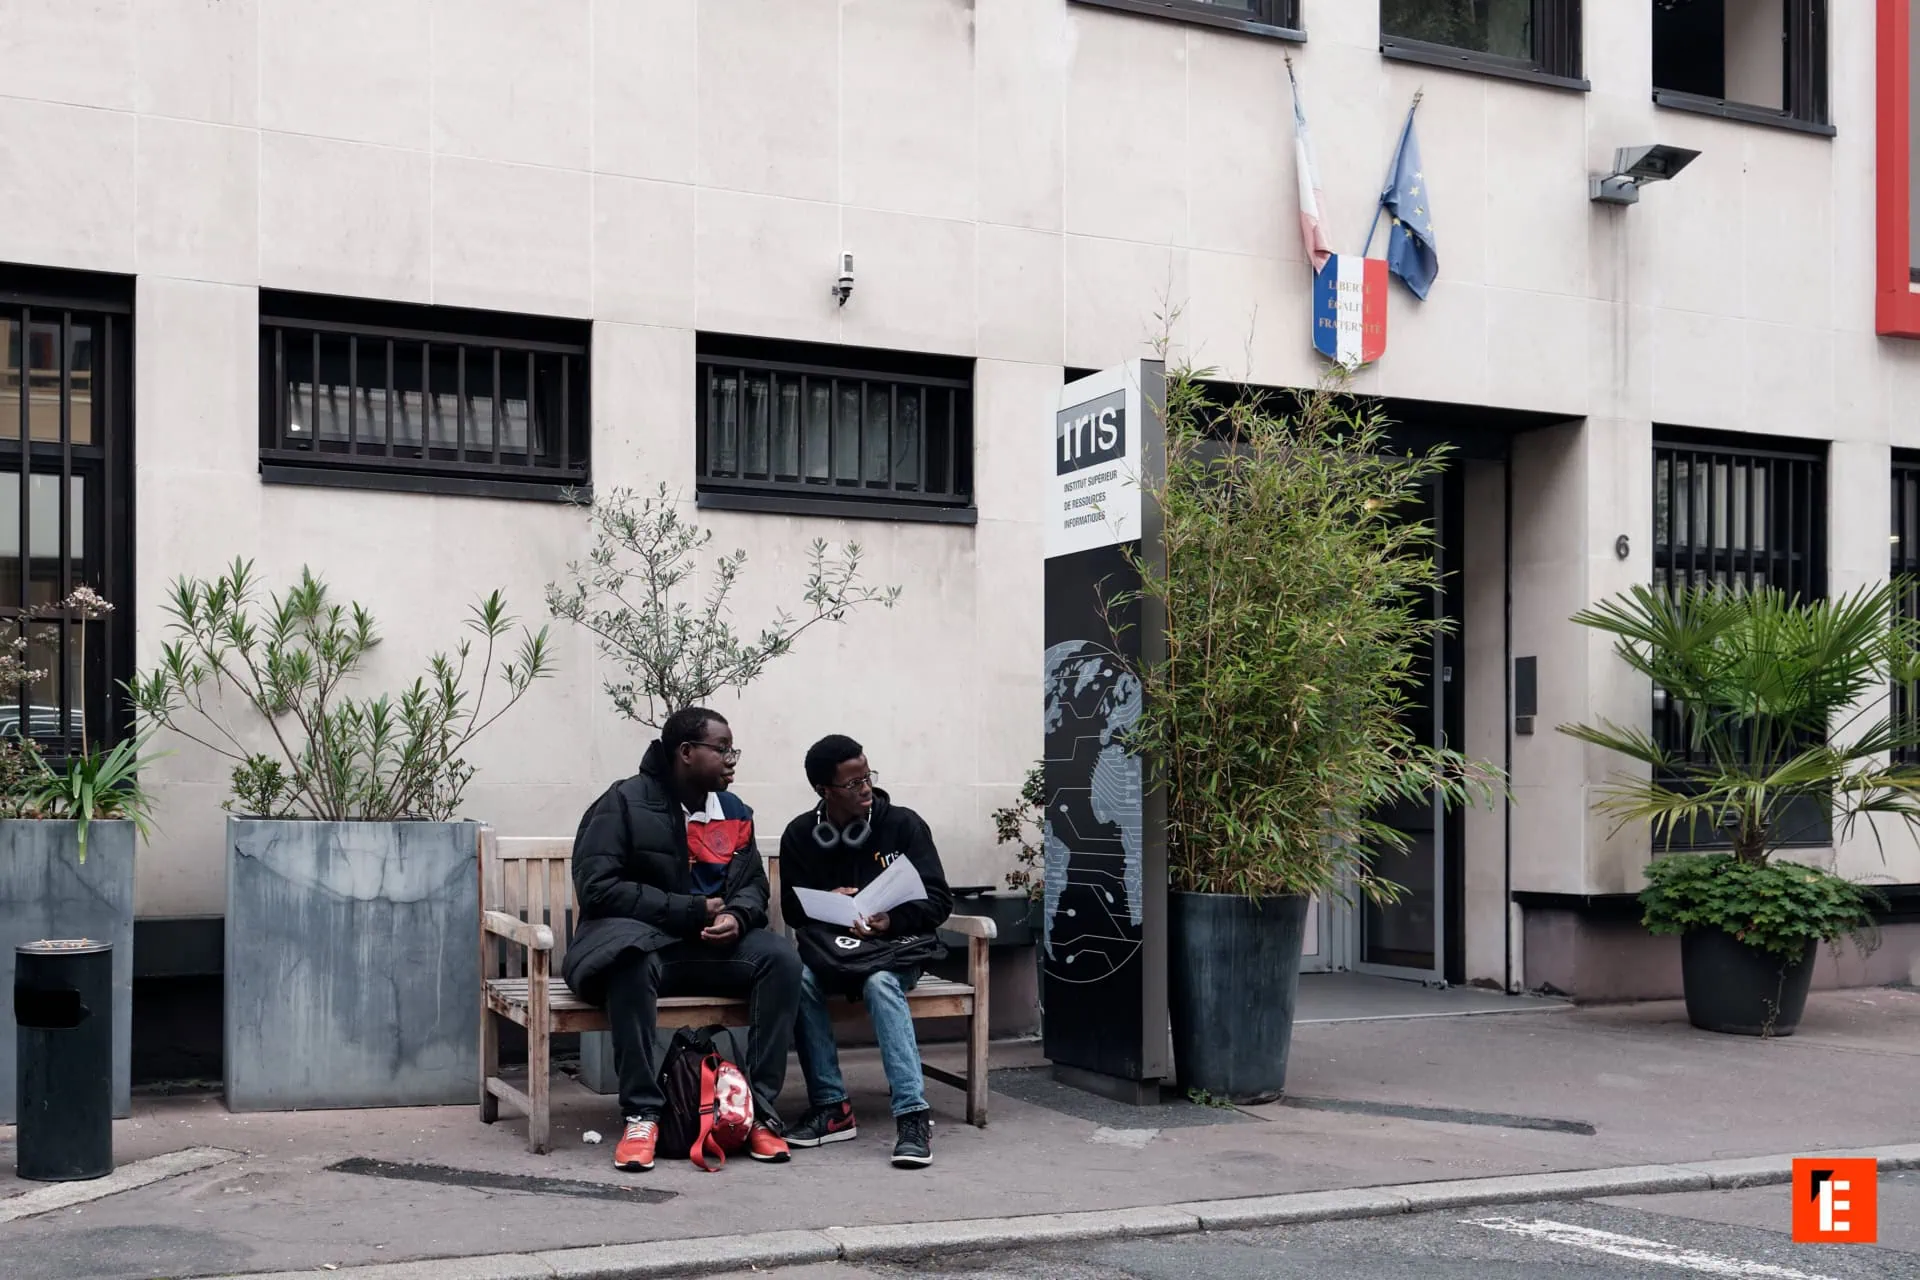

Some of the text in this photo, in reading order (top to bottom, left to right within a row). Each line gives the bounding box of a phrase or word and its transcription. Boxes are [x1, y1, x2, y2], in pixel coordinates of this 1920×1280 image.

[1328, 296, 1373, 314] ÉGALIÉ
[1064, 469, 1118, 492] INSTITUT SUPÉRIEUR
[1063, 491, 1106, 511] DE RESSOURCES
[1064, 510, 1106, 529] INFORMATIQUES
[1615, 534, 1630, 560] 6
